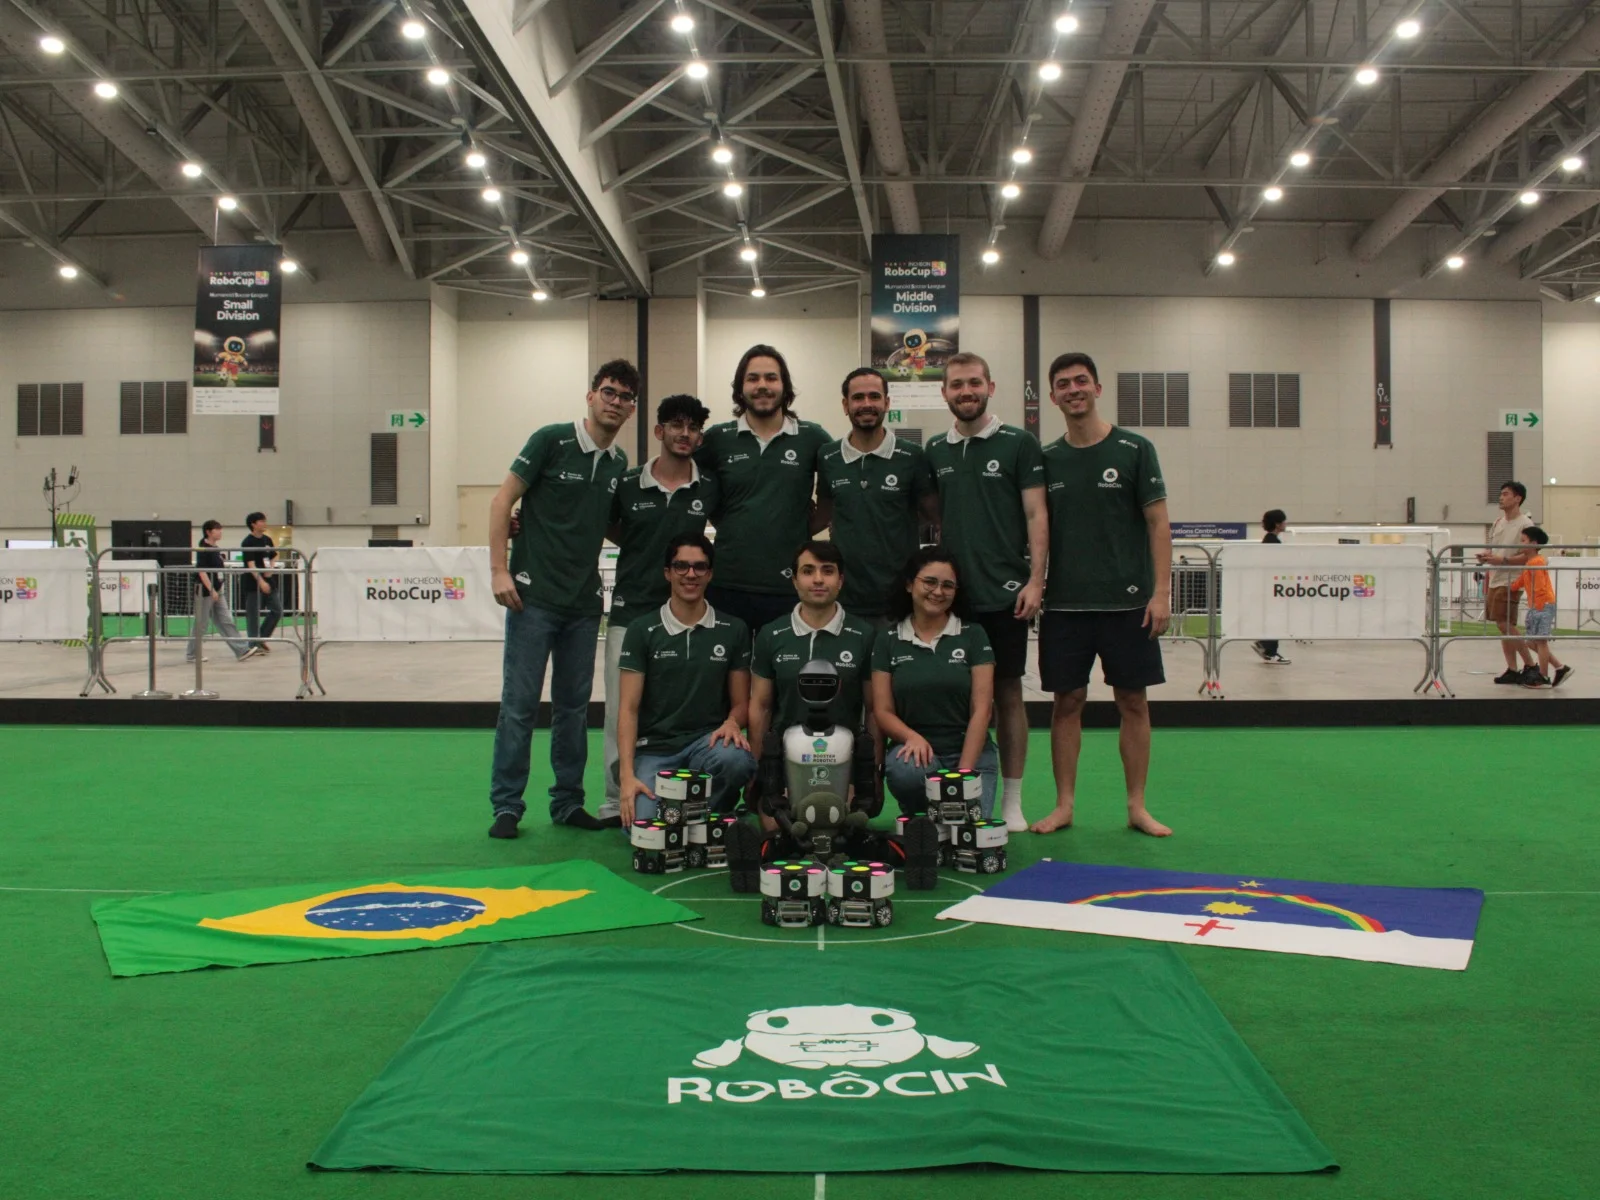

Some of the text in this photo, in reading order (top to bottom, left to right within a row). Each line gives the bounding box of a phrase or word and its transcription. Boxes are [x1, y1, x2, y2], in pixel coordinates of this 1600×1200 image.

[884, 267, 931, 278] RoboCup
[210, 276, 255, 287] RoboCup
[896, 291, 934, 301] Middle
[223, 300, 253, 309] Small
[893, 302, 937, 313] Division
[217, 310, 259, 320] Division
[366, 586, 442, 603] RoboCup
[1273, 583, 1350, 601] RoboCup
